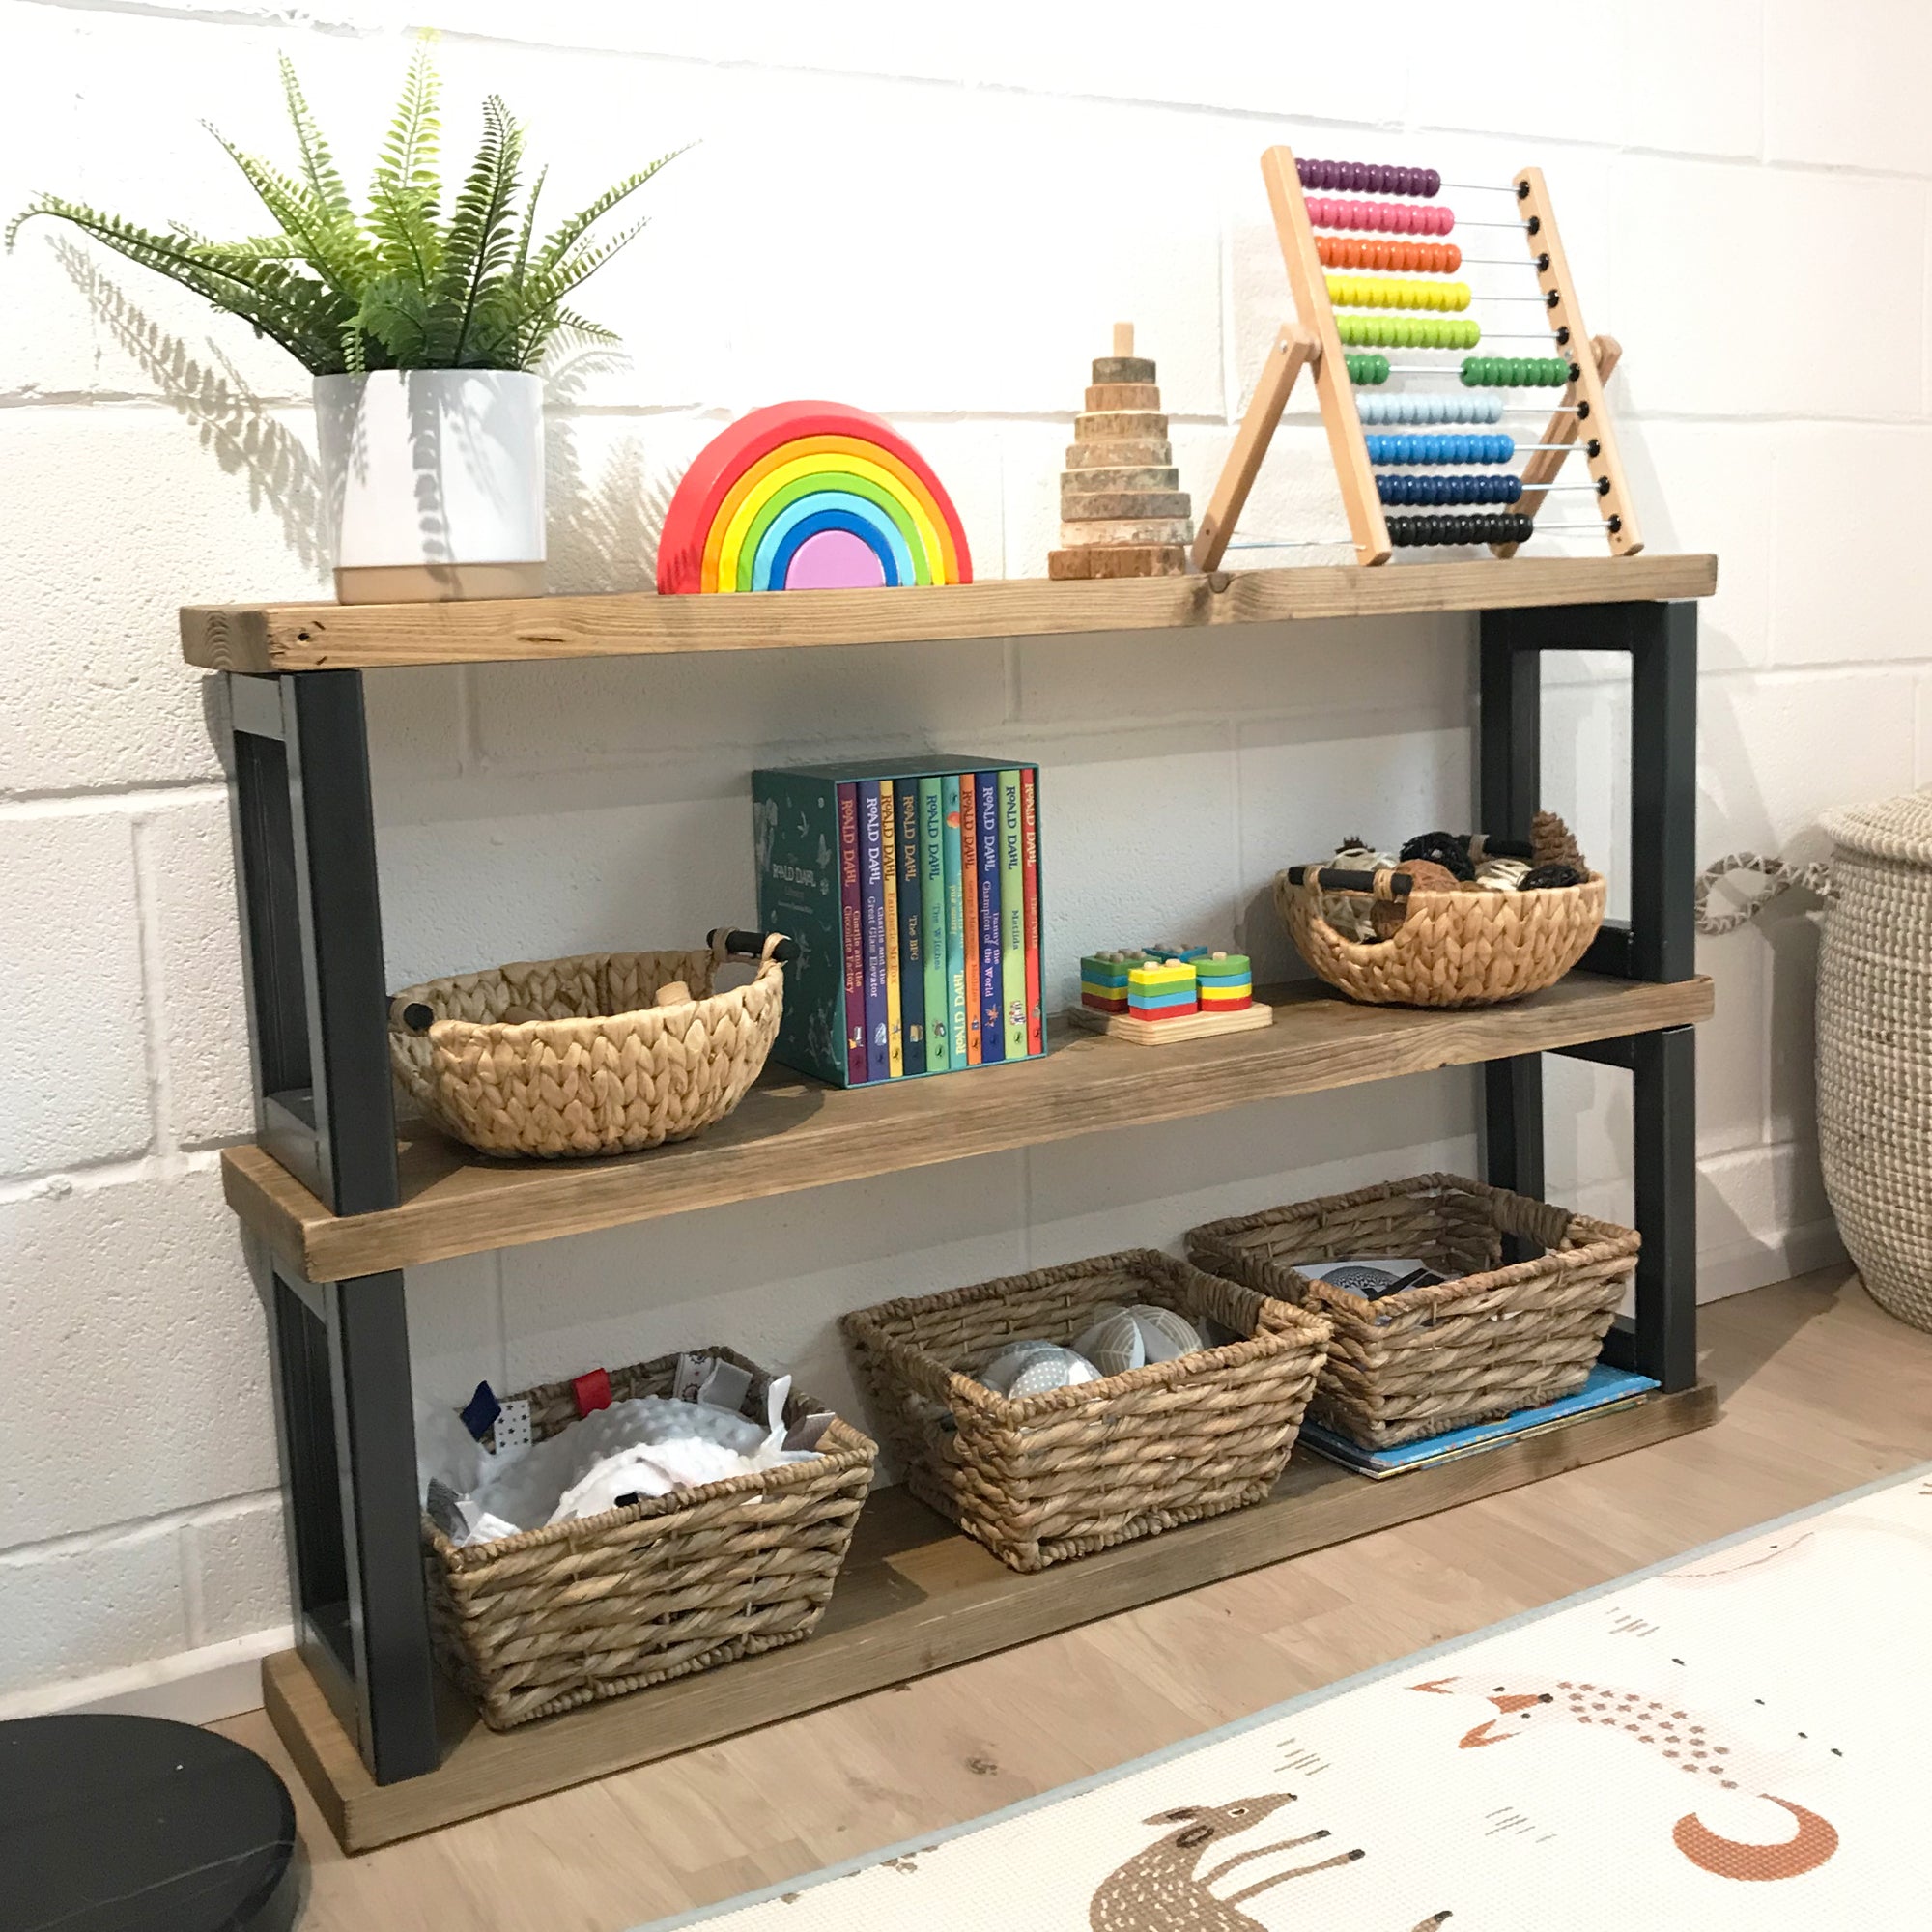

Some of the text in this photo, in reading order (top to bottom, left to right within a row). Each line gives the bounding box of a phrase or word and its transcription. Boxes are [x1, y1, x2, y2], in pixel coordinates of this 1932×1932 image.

[841, 800, 857, 888] ROALD DAHL
[867, 797, 881, 885] ROALD DAHL
[881, 795, 895, 882] ROALD DAHL
[902, 795, 917, 882] ROALD DAHL
[926, 794, 940, 881] ROALD DAHL
[962, 790, 975, 870] ROALD DAHL
[982, 786, 996, 872] ROALD DAHL
[1006, 786, 1019, 870] ROALD DAHL
[1024, 783, 1037, 867] ROALD DAHL
[853, 910, 862, 946] Charlie
[867, 896, 878, 997] Great Glass Elevator
[887, 892, 896, 941] Fantastic
[909, 915, 919, 961] The BFG
[931, 903, 942, 971] The Witches
[980, 880, 991, 931] Champion
[983, 934, 992, 945] of
[844, 906, 854, 994] Chocolate Factory
[889, 947, 896, 962] Mr
[984, 966, 994, 998] World
[953, 970, 966, 1055] ROALD DAHL
